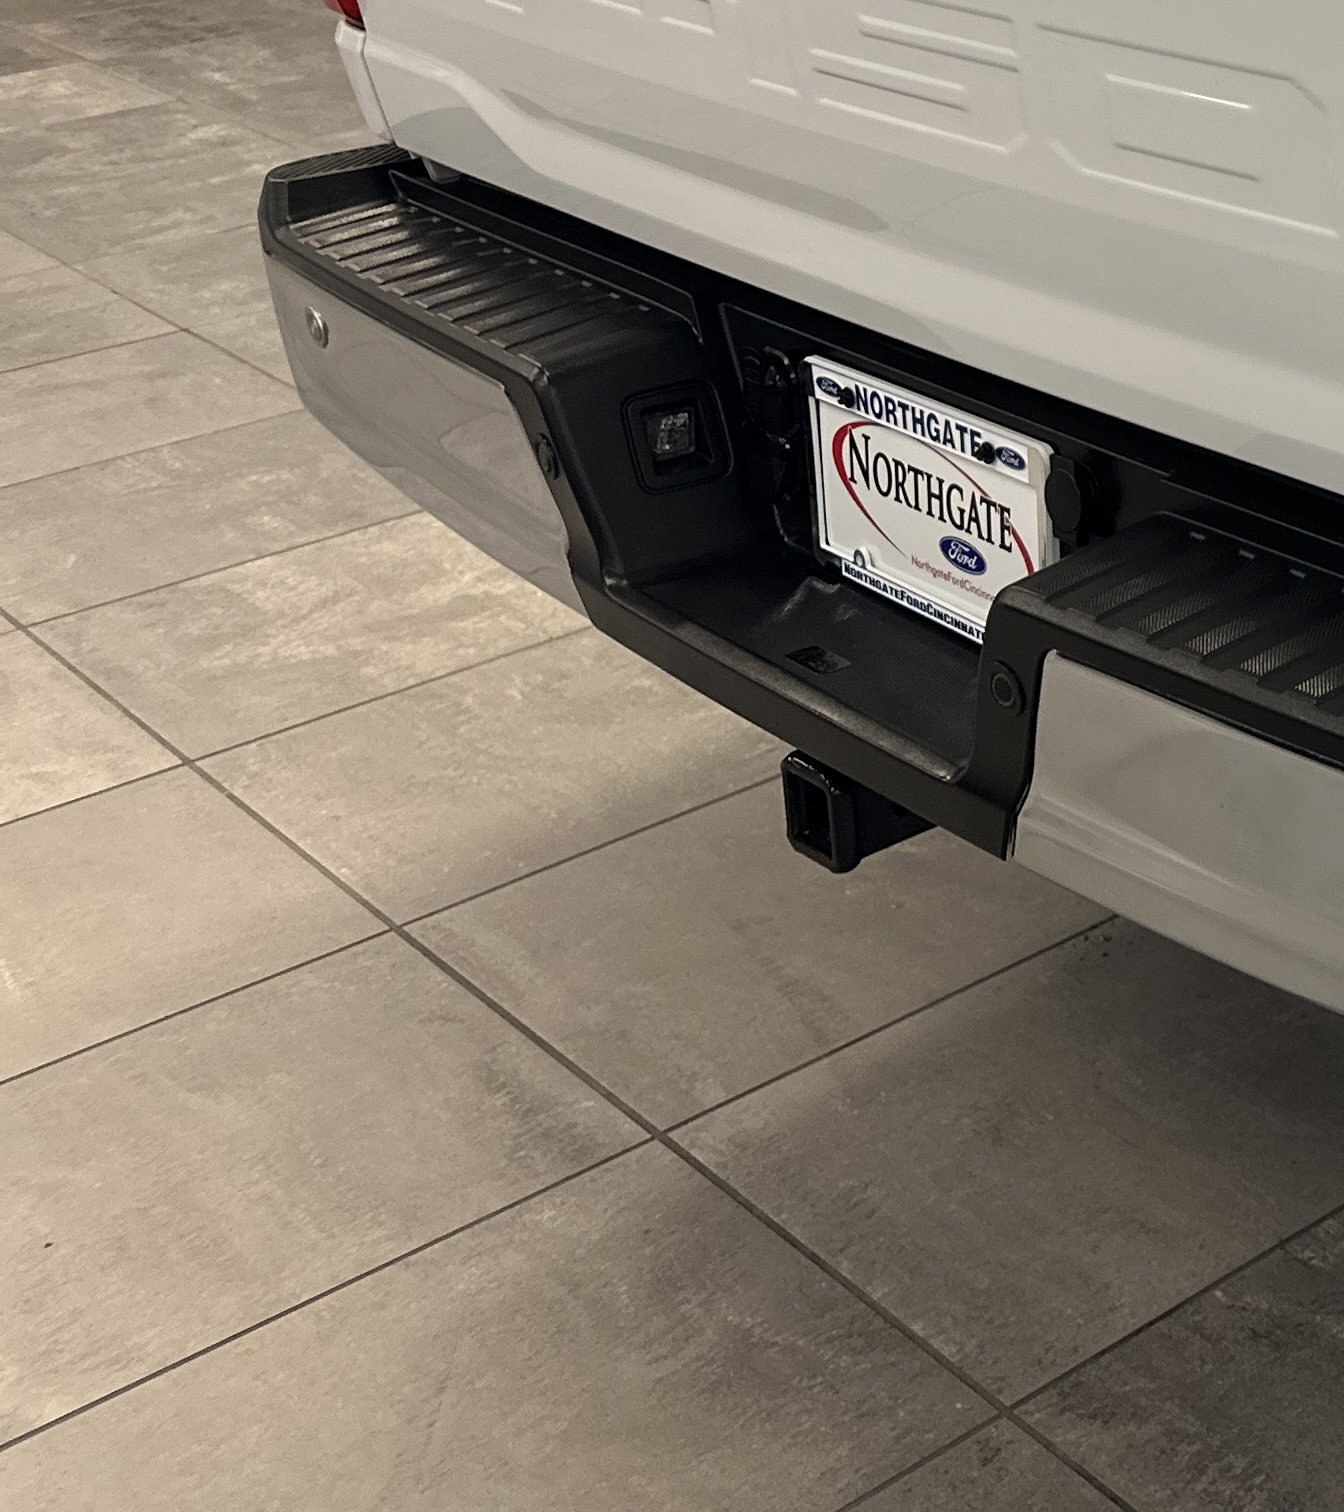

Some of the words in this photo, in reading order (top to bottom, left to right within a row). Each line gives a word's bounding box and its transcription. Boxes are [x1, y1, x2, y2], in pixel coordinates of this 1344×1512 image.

[855, 383, 983, 455] NORTHGATE
[848, 425, 1013, 553] NORTHGATE
[948, 541, 978, 569] Ford
